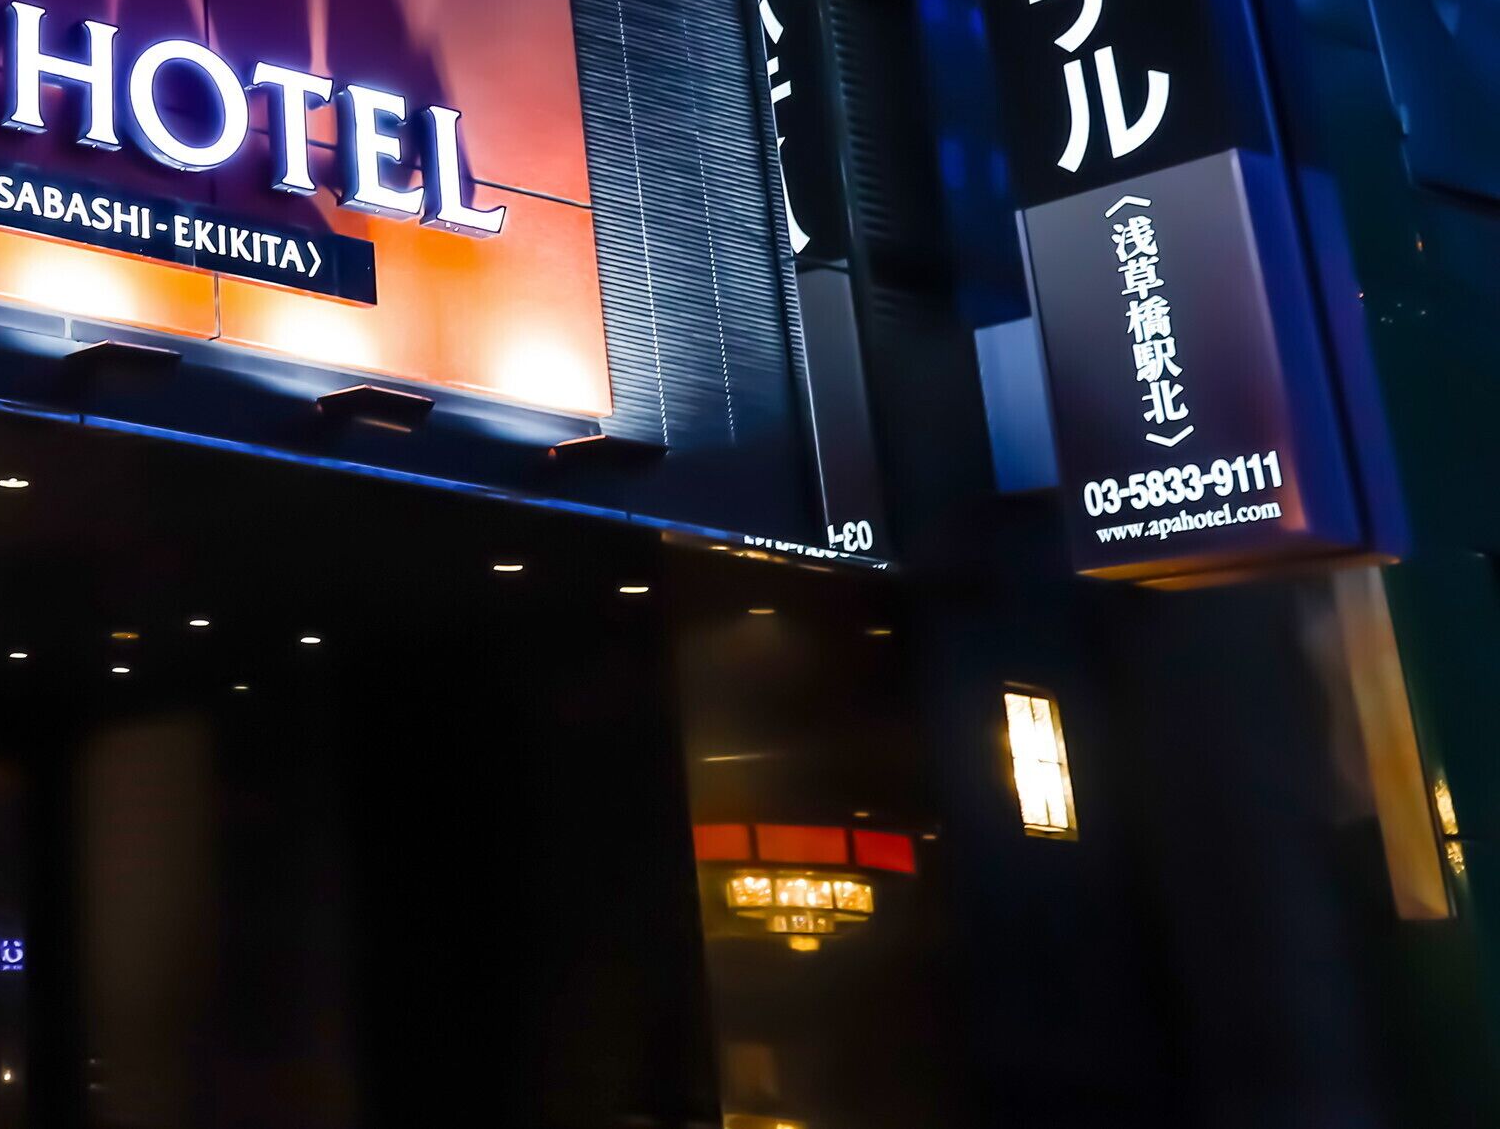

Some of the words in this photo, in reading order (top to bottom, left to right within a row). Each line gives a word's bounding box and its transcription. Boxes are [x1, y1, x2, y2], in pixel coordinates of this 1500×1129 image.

[2, 0, 506, 238] HOTEL
[1084, 450, 1283, 517] 03-5833-9111
[1096, 502, 1283, 544] www.apahotel.com
